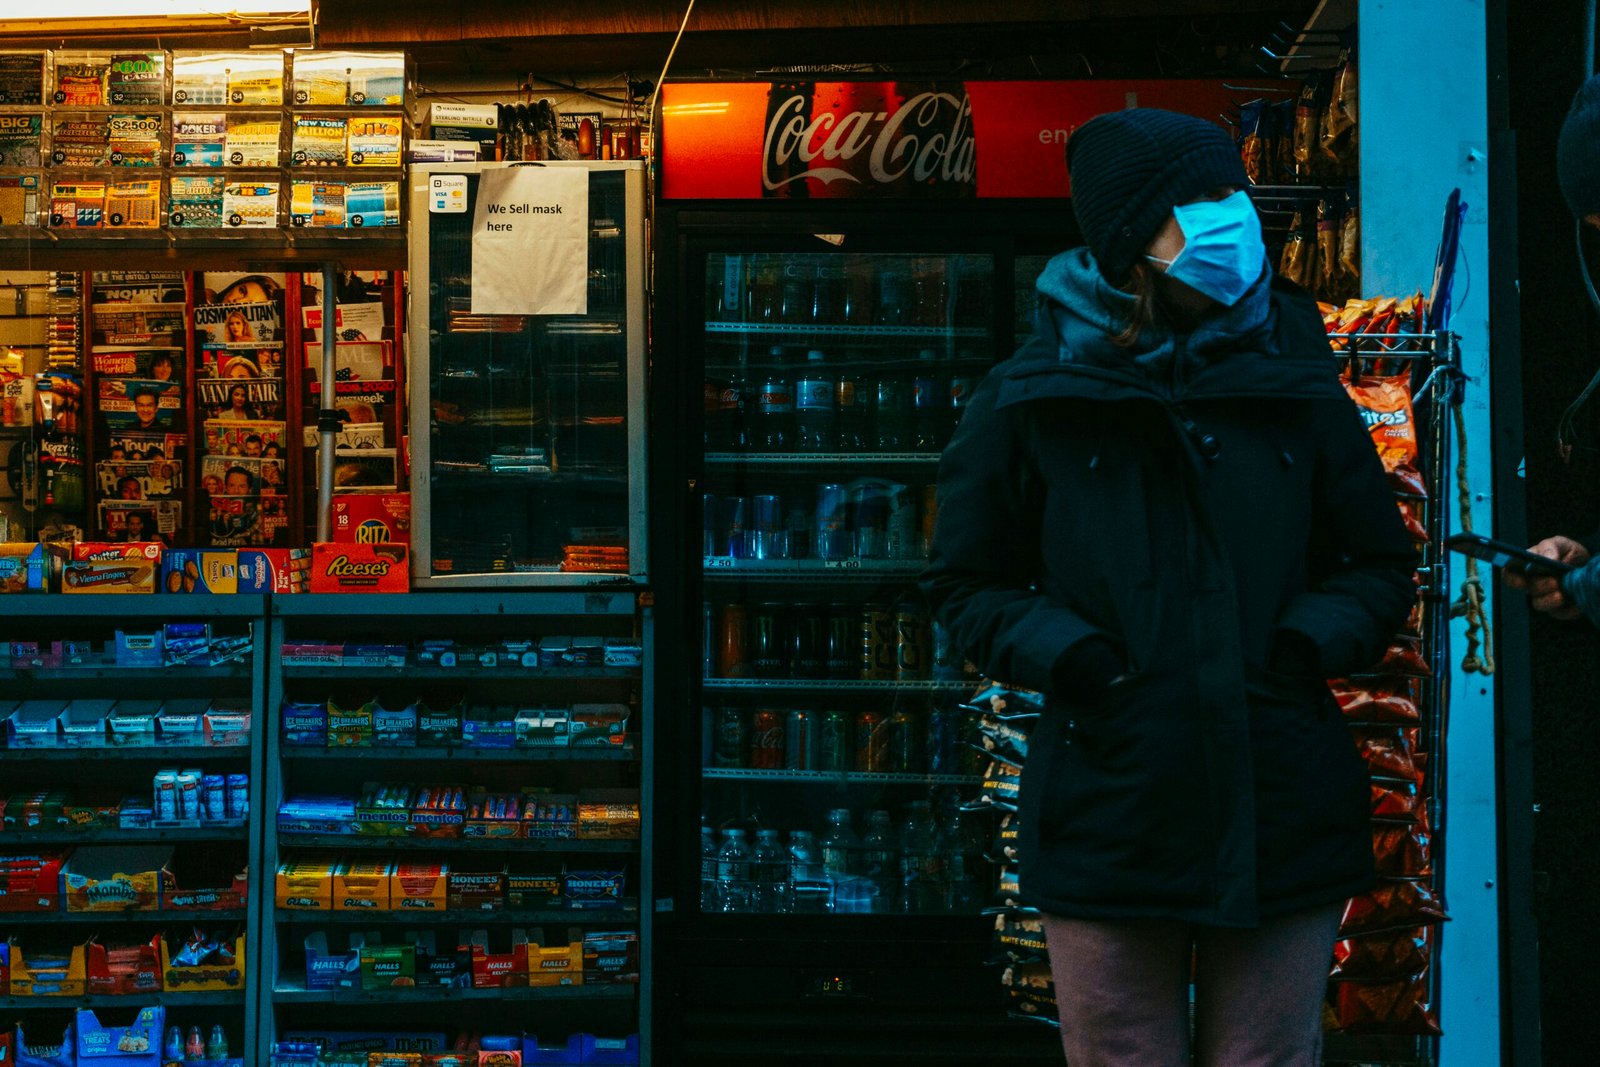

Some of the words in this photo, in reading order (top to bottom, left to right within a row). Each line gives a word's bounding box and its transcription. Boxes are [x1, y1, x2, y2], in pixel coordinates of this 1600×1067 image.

[177, 92, 186, 100] 33
[354, 94, 364, 102] 36
[1, 117, 30, 127] BIG
[181, 125, 216, 134] POKER
[297, 127, 343, 137] MILLION
[351, 123, 399, 137] WILD
[1039, 124, 1075, 144] en
[762, 92, 976, 190] Coca-Cola
[443, 180, 464, 188] Square
[487, 204, 506, 214] We
[509, 203, 529, 214] Sell
[533, 203, 562, 214] mask
[487, 222, 512, 232] here
[195, 306, 274, 324] COSMLITAN
[109, 336, 151, 344] Examiner
[340, 346, 367, 360] ME
[94, 354, 136, 364] Woman's
[95, 364, 125, 374] World
[363, 382, 394, 392] 2020
[201, 384, 231, 403] VANI
[248, 383, 278, 402] FAIR
[1361, 410, 1407, 425] itos
[225, 428, 280, 445] cloer
[204, 460, 224, 472] Life
[338, 515, 349, 524] 18
[358, 526, 388, 544] RITZ
[90, 550, 120, 561] Nutter
[326, 555, 390, 576] Reese's
[211, 560, 219, 583] Toasty
[79, 574, 102, 583] Vienna
[103, 571, 126, 580] Fingers
[296, 717, 323, 726] BREAKERS
[341, 716, 369, 726] BREAKERS
[385, 719, 413, 729] BREAKERS
[430, 717, 458, 727] BREAKERS
[359, 813, 407, 821] mentos
[412, 815, 463, 824] mentos
[279, 823, 322, 831] menos
[451, 876, 498, 884] HONEES
[509, 880, 556, 888] HONEES
[568, 880, 615, 888] HONEES
[88, 884, 137, 901] Mamba
[287, 898, 320, 907] Rila
[344, 898, 377, 907] Rica
[401, 898, 435, 908] Rila
[1001, 935, 1019, 945] WHITE
[313, 961, 345, 970] HALLS
[599, 957, 624, 965] HALLS
[142, 1012, 153, 1020] 25
[85, 1037, 111, 1045] TREATS
